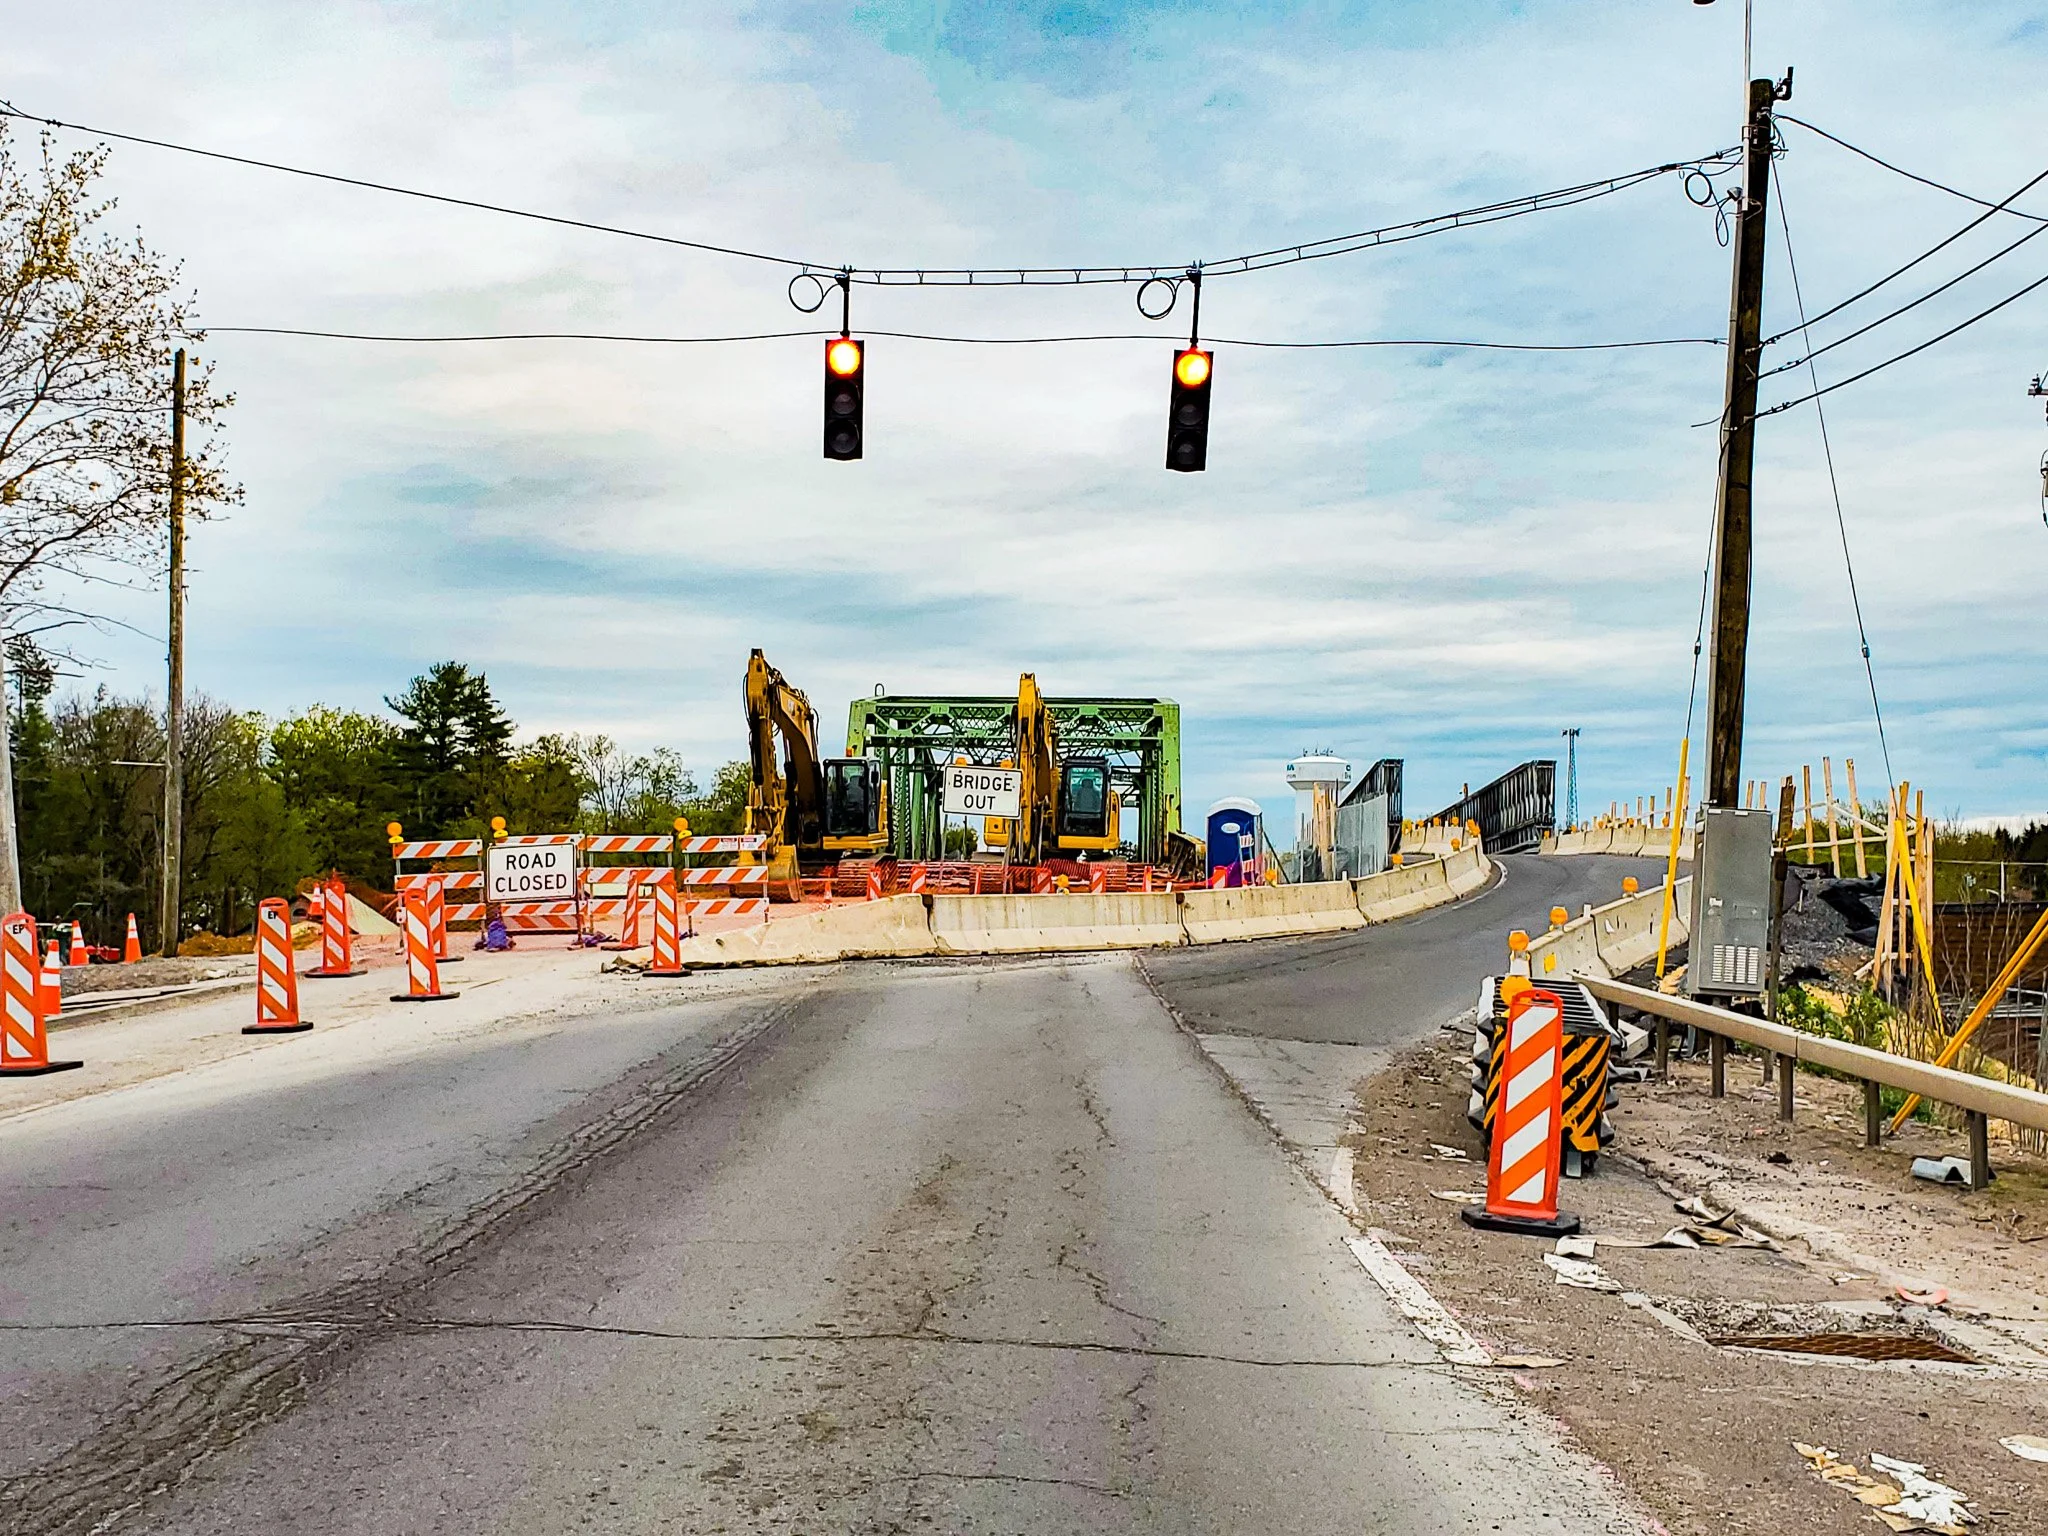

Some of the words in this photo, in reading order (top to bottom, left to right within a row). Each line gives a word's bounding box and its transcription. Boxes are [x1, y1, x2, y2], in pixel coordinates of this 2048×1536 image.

[953, 774, 1013, 792] BRIDGE
[964, 794, 996, 810] OUT
[506, 852, 556, 870] ROAD
[495, 873, 567, 893] CLOSED
